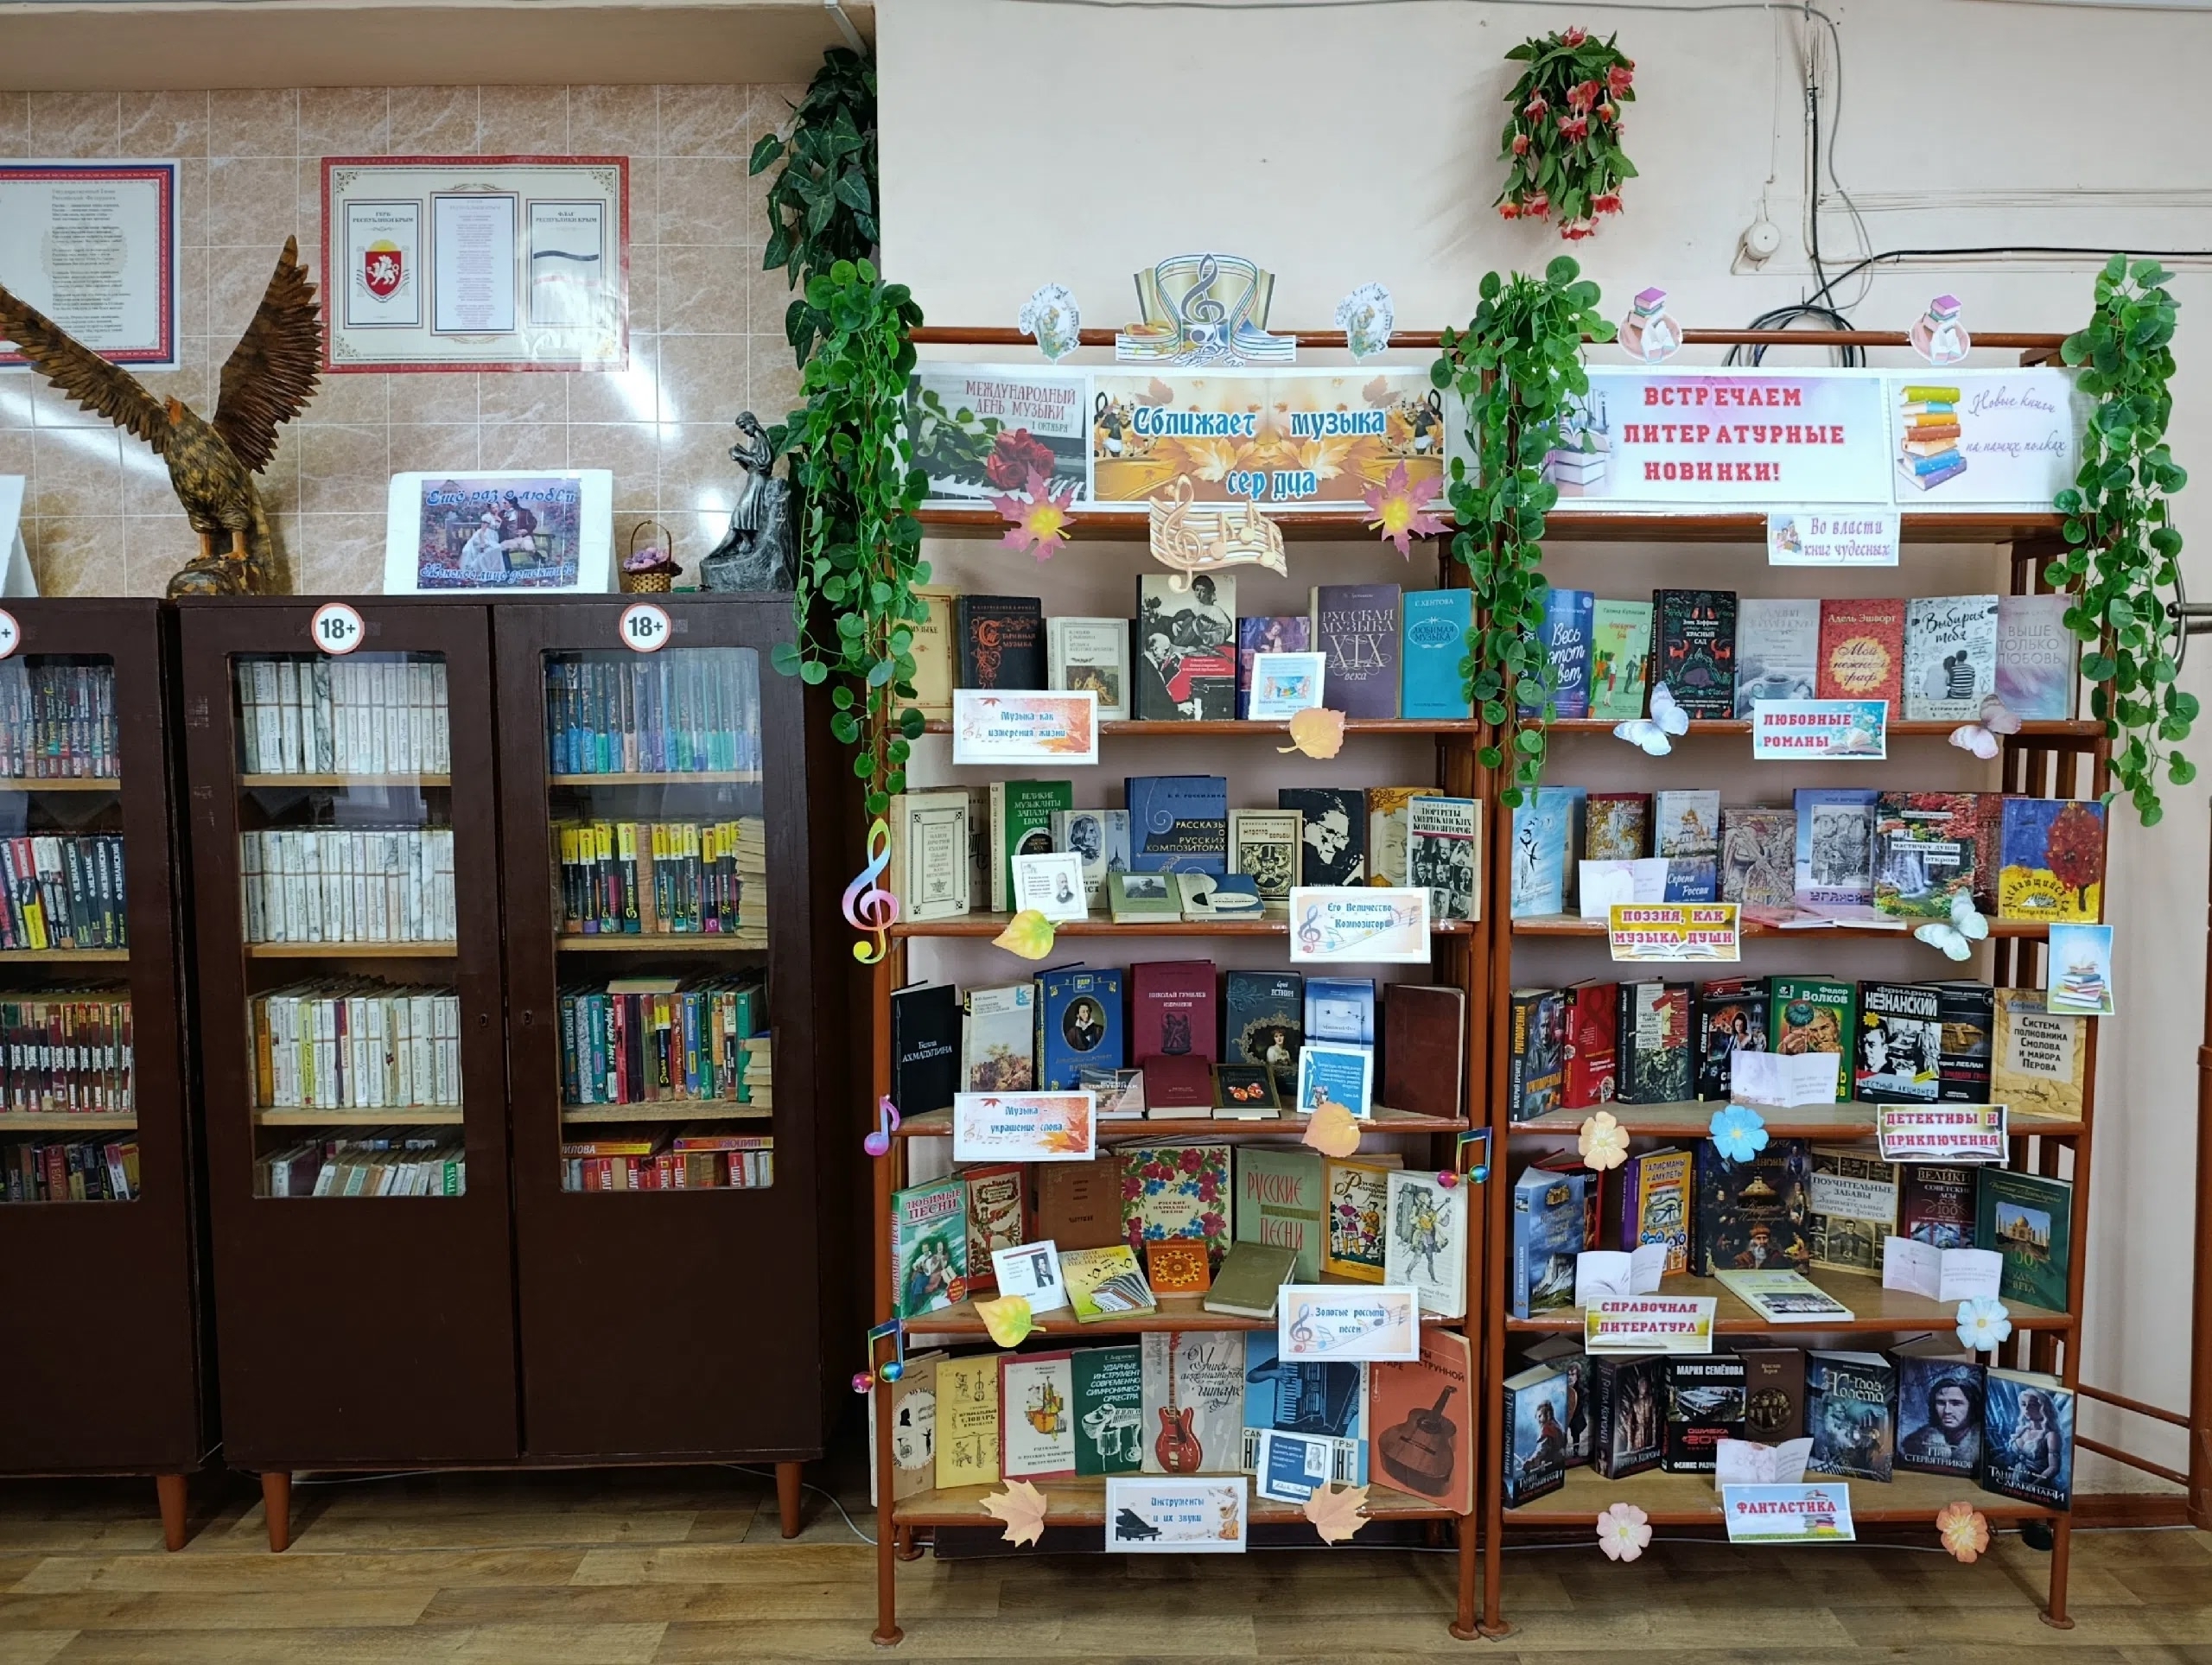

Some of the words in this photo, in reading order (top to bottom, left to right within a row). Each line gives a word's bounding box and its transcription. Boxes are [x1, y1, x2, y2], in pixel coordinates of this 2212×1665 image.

[966, 380, 1077, 404] МЕЖДУНАРОДНЫЙ
[1644, 385, 1802, 408] ВСТРЕЧАЕМ
[1968, 389, 2012, 416] Новые
[2013, 391, 2056, 414] книги
[975, 398, 1006, 416] ДЕНЬ
[1012, 401, 1065, 421] МУЗЫКИ
[1039, 422, 1069, 434] ОКТЯБРЯ
[1134, 407, 1255, 437] Сближает
[1290, 408, 1386, 435] музыка
[1966, 440, 1980, 453] на
[1982, 438, 2022, 454] наших
[2024, 435, 2067, 455] полках
[1644, 461, 1782, 483] НОВИНКИ!
[1226, 471, 1265, 500] сер
[1272, 469, 1317, 500] дца
[426, 489, 466, 506] Ещё
[469, 490, 499, 506] раз
[1810, 517, 1829, 536] Во
[1833, 517, 1885, 537] власти
[1804, 540, 1832, 561] книг
[1834, 537, 1891, 563] чудесных
[1321, 609, 1394, 622] РУССКАЯ
[1827, 613, 1856, 623] Адель
[1859, 613, 1896, 625] Эшворт
[1923, 607, 1985, 633] Выбирая
[320, 618, 356, 639] 18+
[627, 617, 664, 638] 18+
[1321, 620, 1395, 633] МУЗЫКА
[2008, 625, 2052, 637] ВЫШЕ
[1414, 633, 1451, 642] МУЗЫКА
[1552, 622, 1580, 647] Весь
[1936, 624, 1967, 644] тебя
[1329, 633, 1386, 670] XIX
[1837, 642, 1878, 657] Мой
[1999, 639, 2059, 651] ТОЛЬКО
[1548, 645, 1586, 664] этот
[1997, 652, 2061, 664] ЛЮБОВЬ
[1344, 670, 1367, 682] века
[1558, 666, 1582, 684] вет
[1001, 710, 1035, 723] Музыка
[1039, 712, 1054, 721] как
[1764, 714, 1852, 726] ЛЮБОВНЫЕ
[988, 728, 1034, 738] измерения
[1039, 728, 1065, 737] жизни
[1764, 736, 1829, 747] РОМАНЫ
[1021, 791, 1054, 800] ВЕЛИКИЕ
[1014, 799, 1061, 810] МУЗЫКАНТЫ
[1421, 807, 1461, 817] ПОРТРЕТЫ
[1346, 902, 1392, 912] Величество
[1694, 910, 1724, 922] КАК
[1335, 918, 1385, 930] Композитор
[1615, 932, 1680, 944] МУЗЫКА
[1820, 986, 1849, 995] Федор
[1865, 992, 1937, 1017] НЕЗНАНСКИЙ
[563, 1009, 575, 1050] КЛЮЕВА
[901, 1045, 953, 1063] АХМАДУЛИНА
[1005, 1106, 1038, 1116] Музыка
[1886, 1112, 1979, 1126] ДЕТЕКТИВЫ
[1987, 1112, 1998, 1125] И
[991, 1122, 1035, 1134] украшение
[1039, 1122, 1063, 1132] слова
[1644, 1159, 1685, 1172] ТАЛИСМАНЫ
[1651, 1169, 1683, 1181] АМУЛЕТЫ
[1917, 1167, 1973, 1182] ВЕЛИКИ
[1247, 1171, 1303, 1206] РУССКИЕ
[1813, 1176, 1893, 1193] ПОУЧИТЕЛЬНЫЕ
[905, 1188, 962, 1210] ЛЮБИМЫЕ
[1834, 1189, 1872, 1200] ЗАБАВЫ
[909, 1199, 958, 1219] ПЕСНИ
[1260, 1217, 1303, 1251] ПЕСНИ
[1315, 1307, 1349, 1318] Золотые
[1354, 1308, 1384, 1319] россыпи
[1600, 1302, 1698, 1313] СПРАВОЧНАЯ
[1339, 1325, 1362, 1335] песен
[1103, 1362, 1137, 1371] УДАРНЫЕ
[1676, 1365, 1703, 1376] МАРИЯ
[1705, 1363, 1745, 1376] СЕМЁНОВА
[1093, 1369, 1141, 1380] ИНСТРУМЕНТ
[1103, 1394, 1139, 1402] ОРКЕСТРА
[961, 1414, 996, 1424] СЛОВАРЬ
[1151, 1497, 1205, 1508] Инструменты
[1737, 1502, 1837, 1514] ФАНТАСТИКА
[1164, 1515, 1175, 1523] их
[1179, 1515, 1202, 1523] звуки
